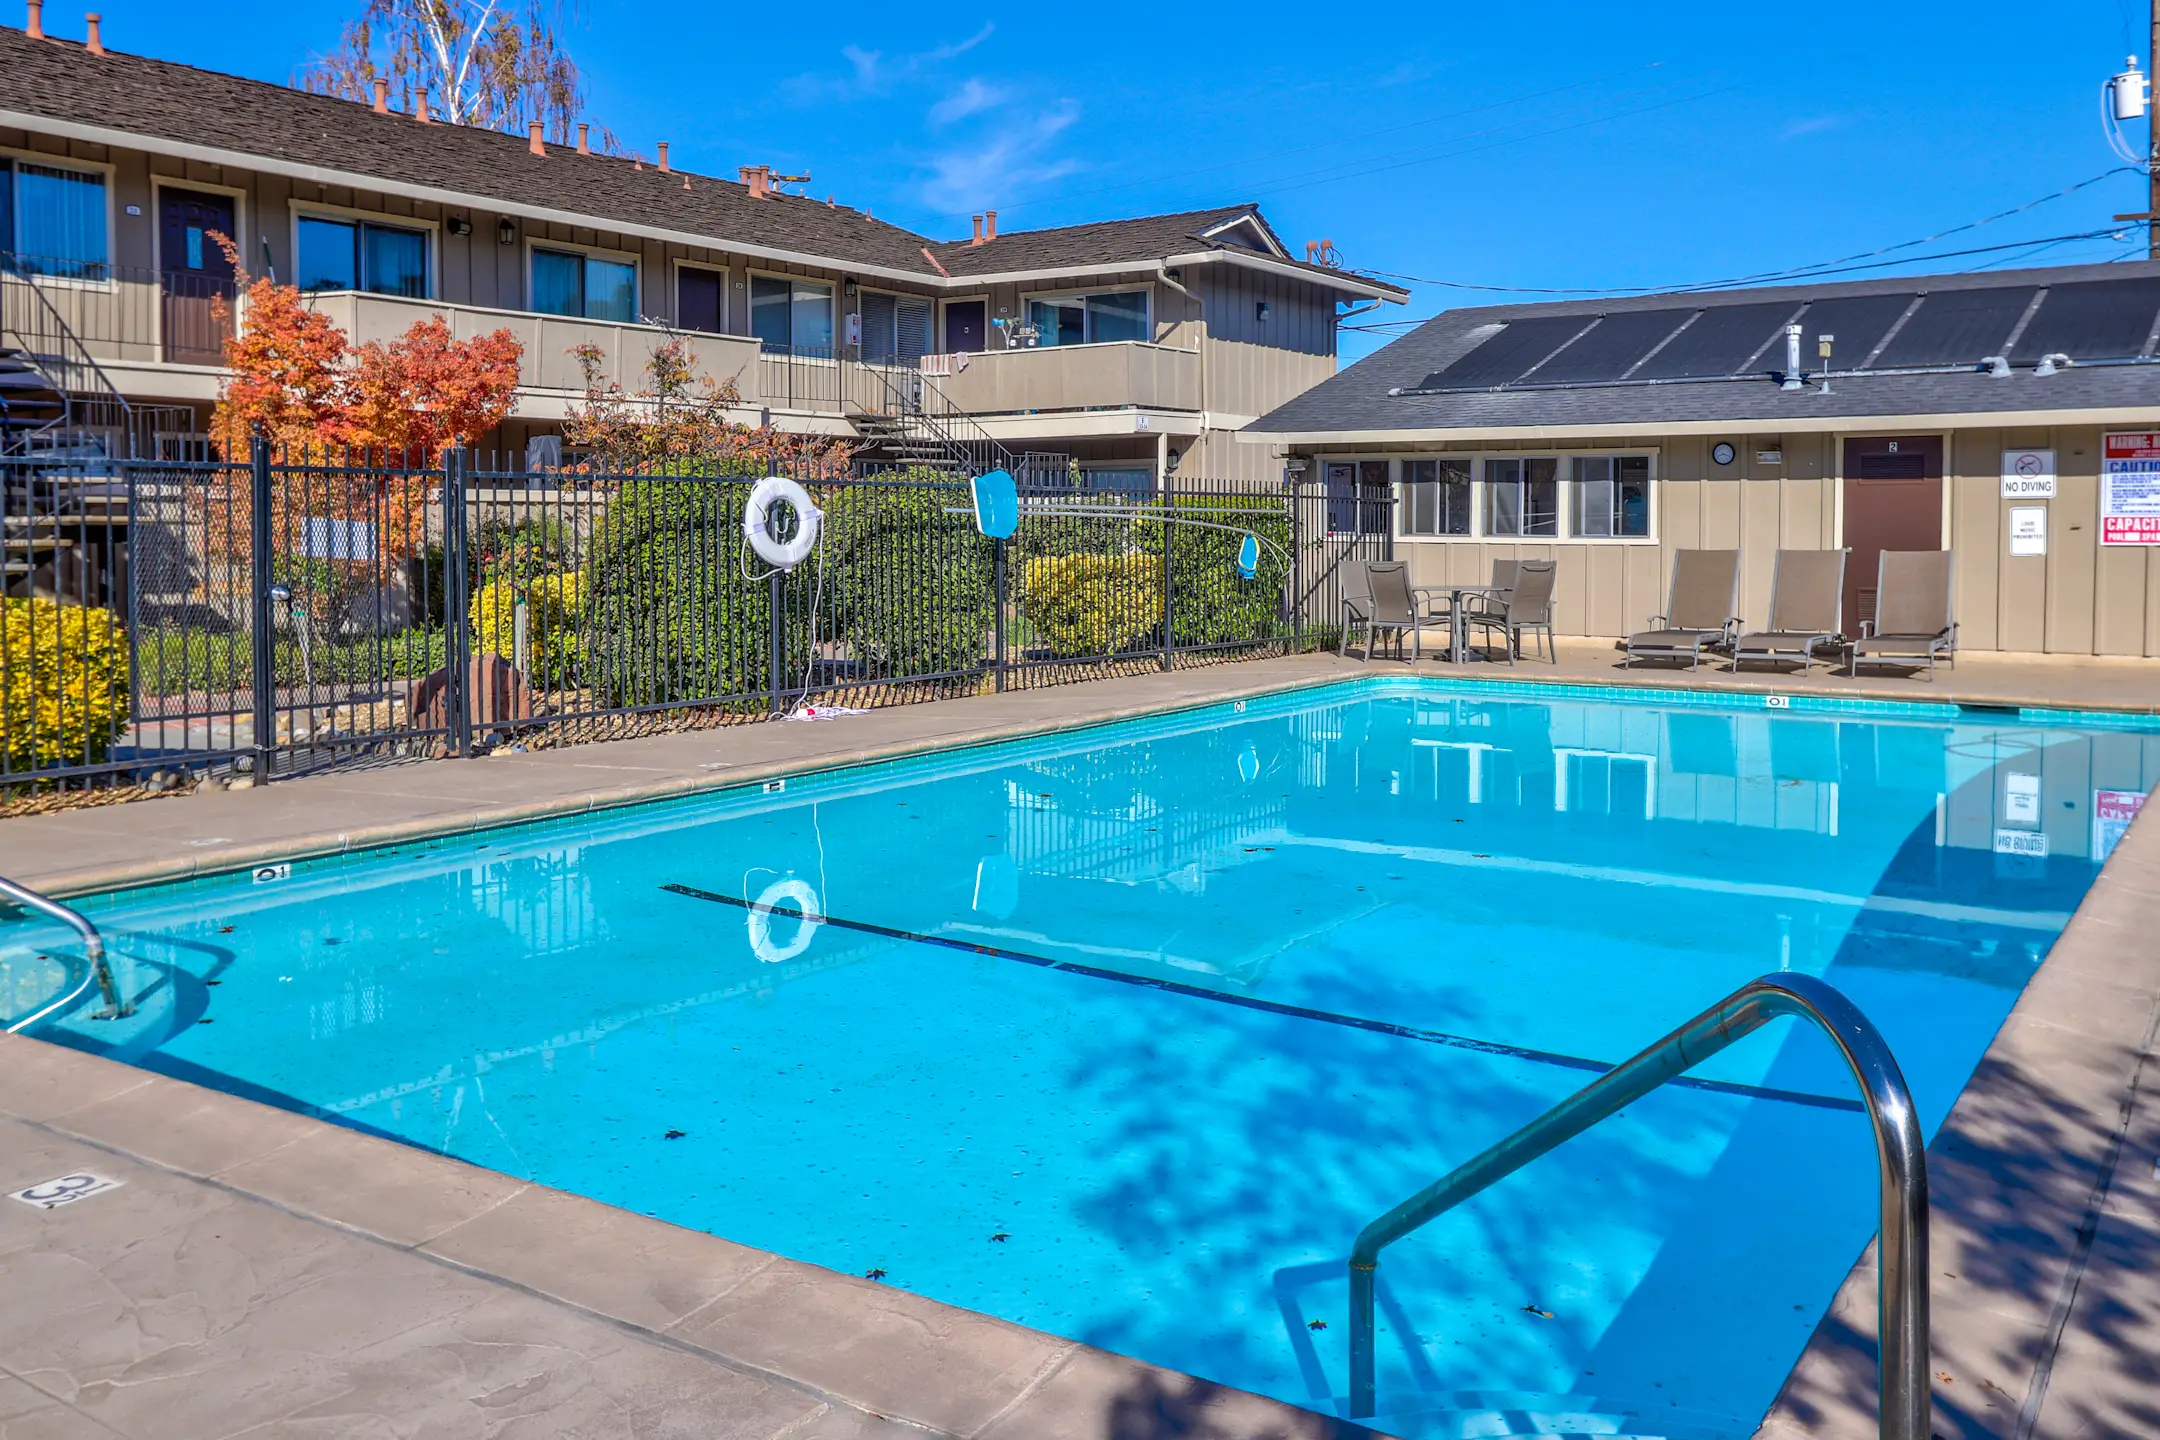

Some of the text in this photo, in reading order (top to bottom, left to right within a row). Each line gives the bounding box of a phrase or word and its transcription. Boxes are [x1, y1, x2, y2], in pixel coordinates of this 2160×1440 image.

[1890, 443, 1896, 451] 2
[2005, 481, 2052, 492] NO DIVING
